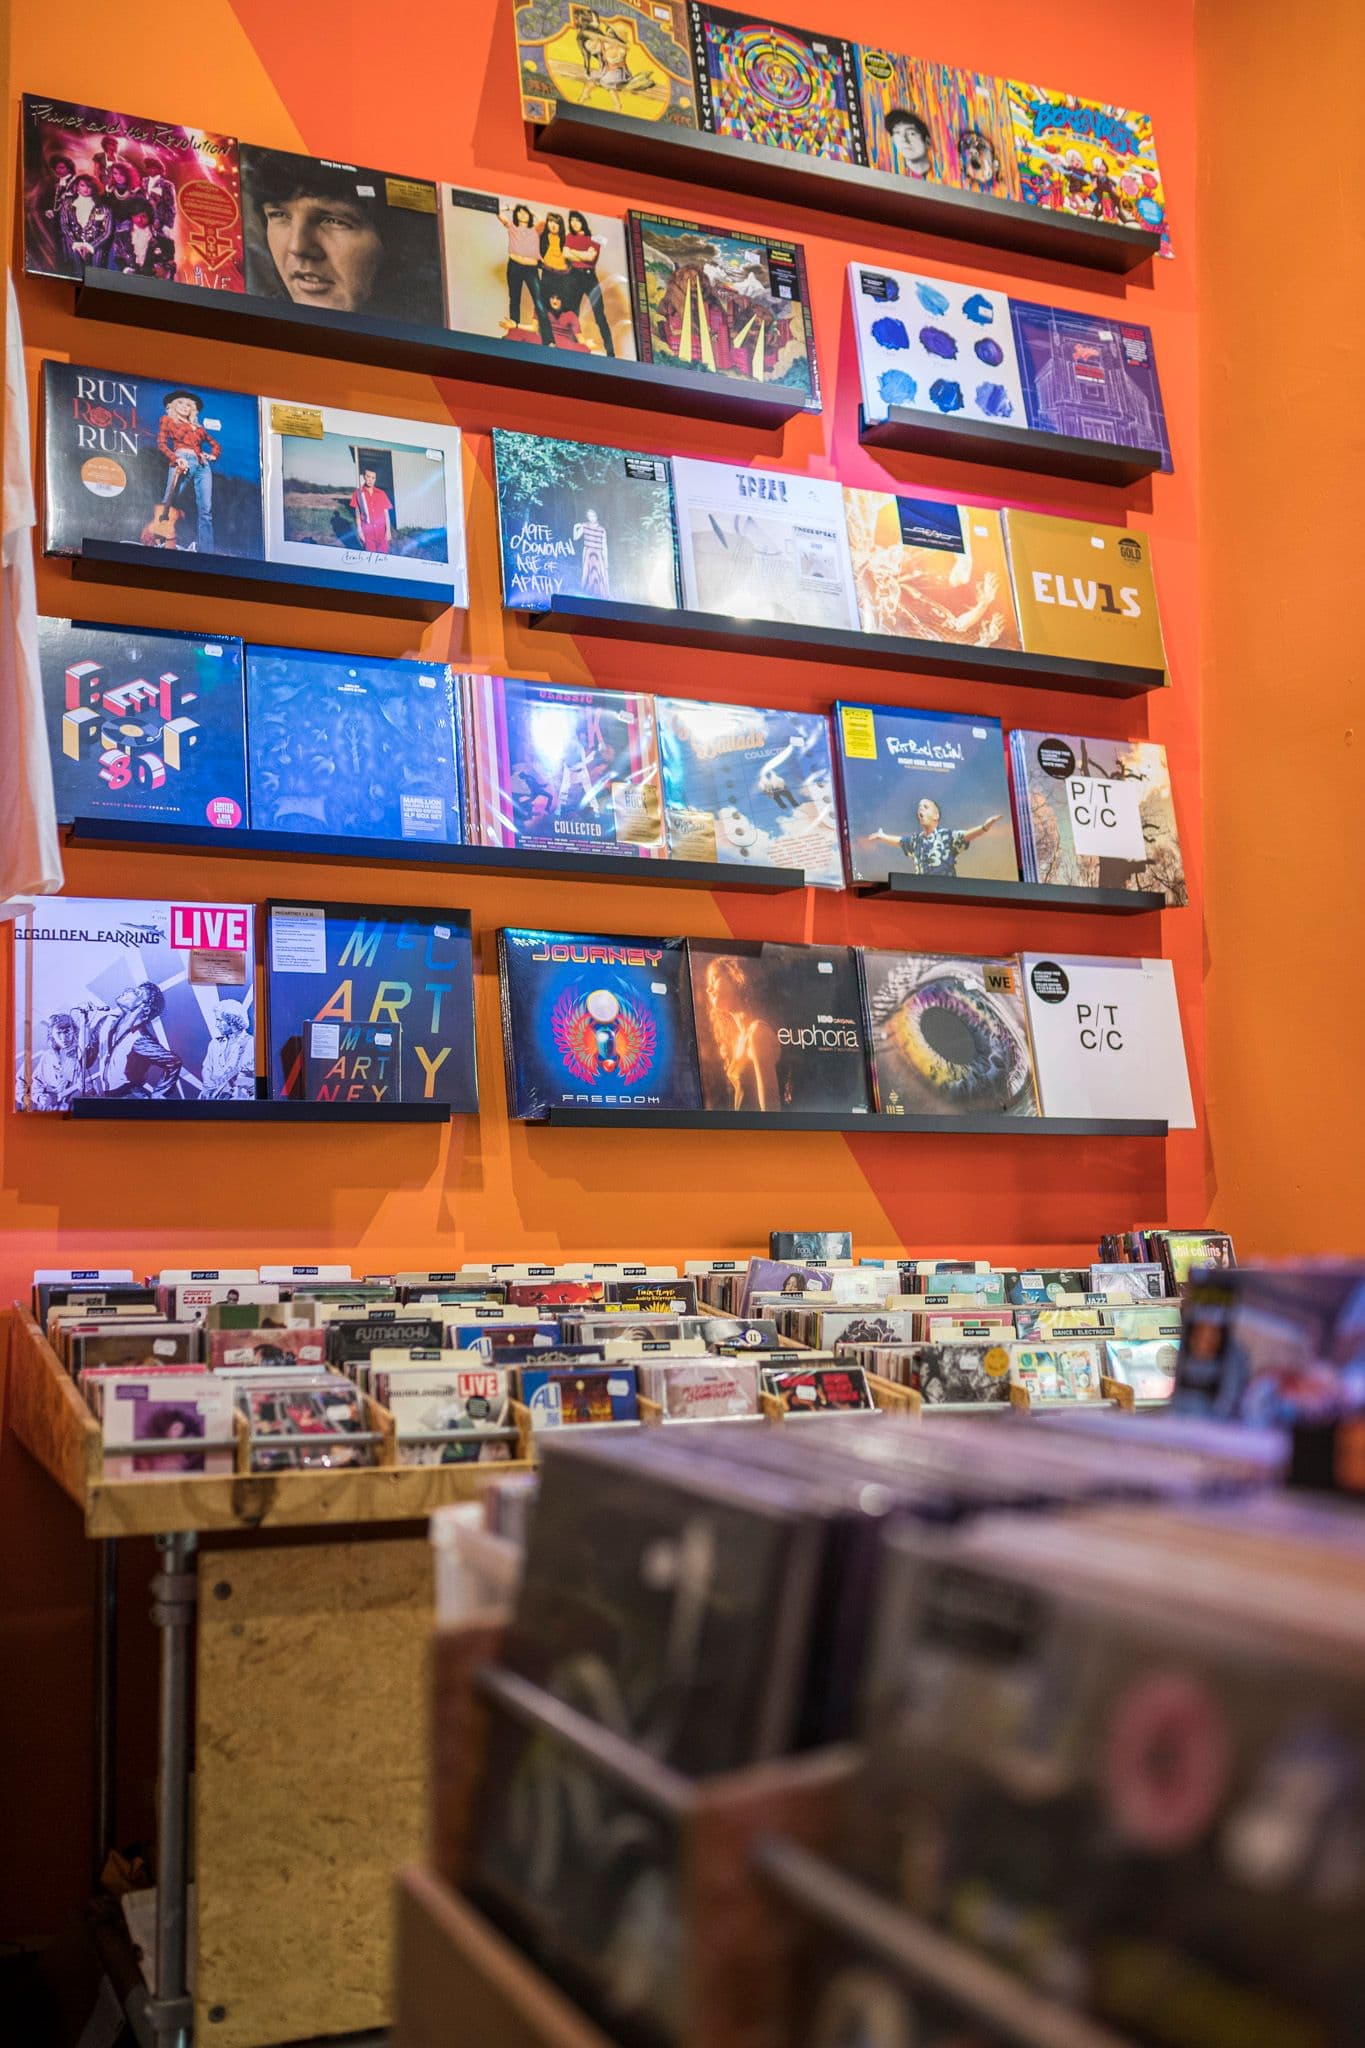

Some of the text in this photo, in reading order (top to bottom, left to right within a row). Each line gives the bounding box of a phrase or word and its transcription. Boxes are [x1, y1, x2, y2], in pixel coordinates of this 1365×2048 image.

[691, 3, 706, 66] SUFJAN
[77, 376, 138, 408] RUN
[77, 424, 139, 456] RUN
[1120, 547, 1142, 561] GOLD
[554, 821, 602, 836] COLLECTED
[97, 929, 160, 948] EARRING
[174, 910, 245, 949] LIVE
[532, 944, 663, 967] JOURNEY
[988, 974, 1011, 990] WE
[777, 1024, 859, 1050] euphoria
[562, 1093, 660, 1105] FREEDOM
[1190, 1242, 1220, 1257] collins
[1086, 1295, 1107, 1304] JAZZ
[1078, 1328, 1115, 1336] ELECTRONIC
[460, 1374, 498, 1397] LIVE
